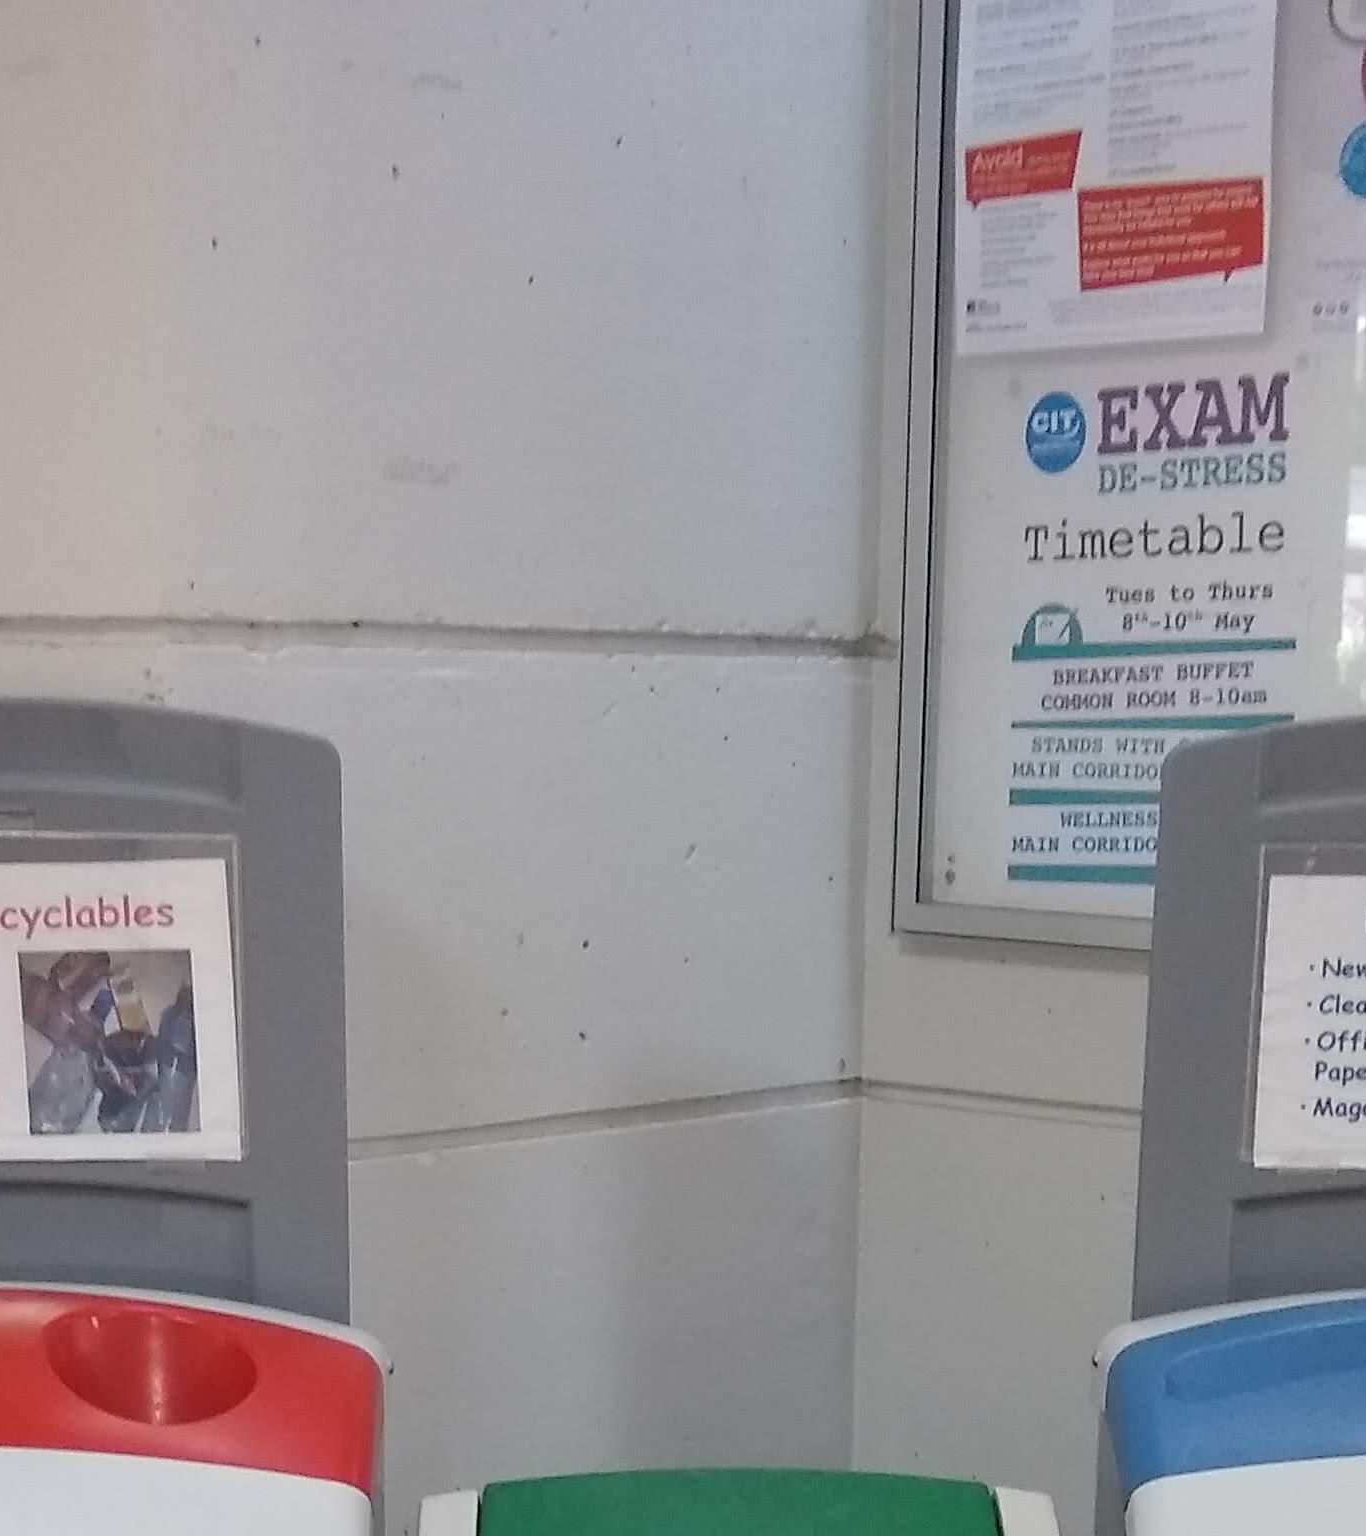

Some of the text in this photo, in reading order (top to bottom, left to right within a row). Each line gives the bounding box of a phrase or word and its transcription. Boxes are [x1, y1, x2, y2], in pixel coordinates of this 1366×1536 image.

[1097, 371, 1291, 455] EXAM
[1098, 451, 1287, 495] DE-STRESS
[1024, 511, 1285, 564] Timetable
[1105, 582, 1274, 604] Tues to Thurs
[1214, 612, 1256, 633] May
[1052, 661, 1254, 686] BREAKFAST BUFFET
[1041, 686, 1268, 711] COMMON ROOM 8-10am
[1032, 736, 1165, 754] STANDS WITH
[1012, 761, 1160, 780] MAIN CORRIDO
[1061, 811, 1157, 828] WELLNESS
[1012, 836, 1158, 853] MAIN CORRIDO
